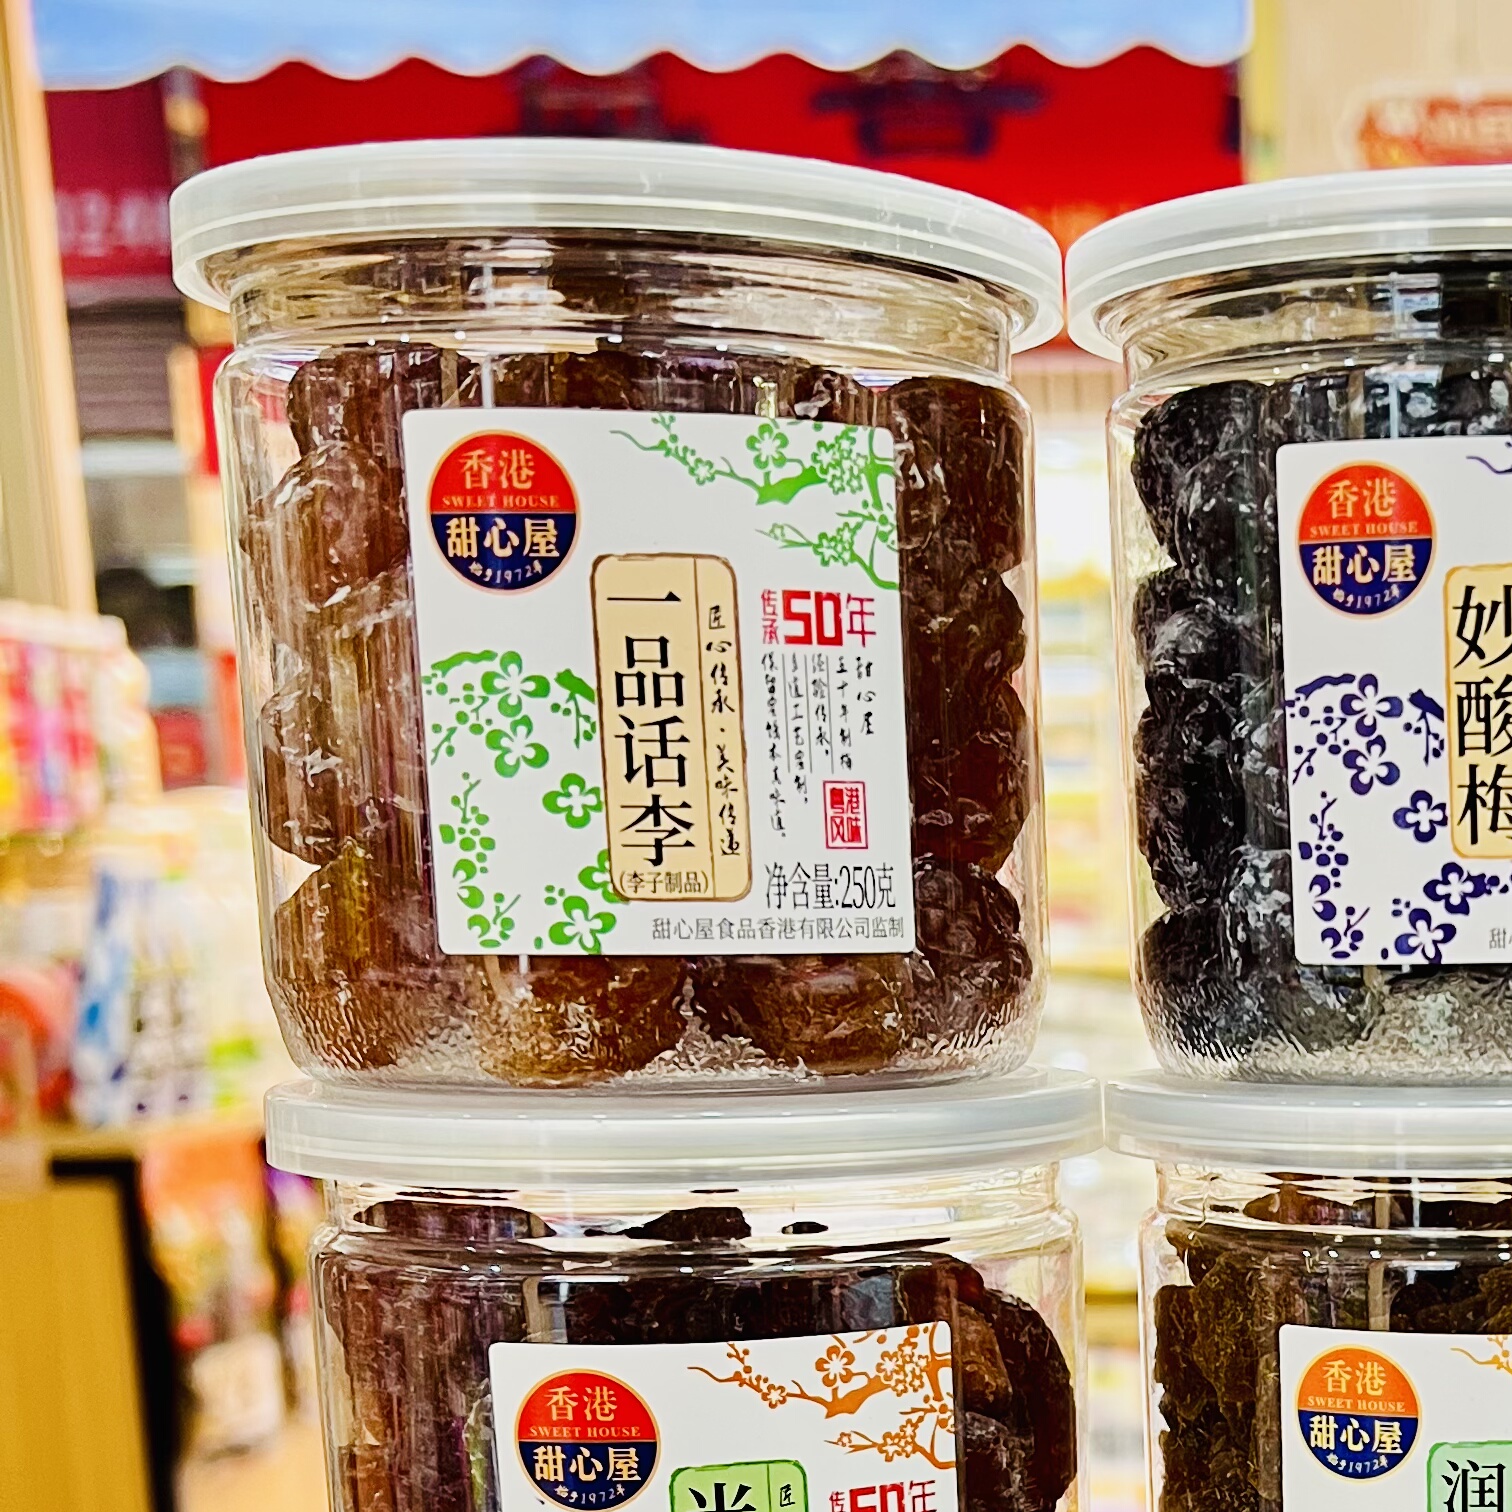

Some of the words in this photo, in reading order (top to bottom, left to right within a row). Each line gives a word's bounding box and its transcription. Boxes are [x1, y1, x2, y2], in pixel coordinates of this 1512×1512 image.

[458, 448, 535, 491] 香港
[1327, 478, 1397, 519] 香港
[446, 517, 561, 560] 甜心屋
[1309, 524, 1361, 538] SWEET
[1364, 521, 1418, 536] HOUSE
[1311, 544, 1418, 586] 甜心屋
[605, 589, 697, 869] 一品话李
[652, 916, 906, 941] 甜心屋食品香港有限公司监制
[1321, 1359, 1388, 1398] 香港
[545, 1385, 618, 1424] 香港
[1307, 1394, 1353, 1409] SWEET
[1357, 1399, 1406, 1414] HOUSE
[529, 1426, 582, 1439] SWEET
[586, 1424, 642, 1439] HOUSE
[1309, 1414, 1405, 1456] 甜心屋
[533, 1446, 642, 1484] 甜心屋
